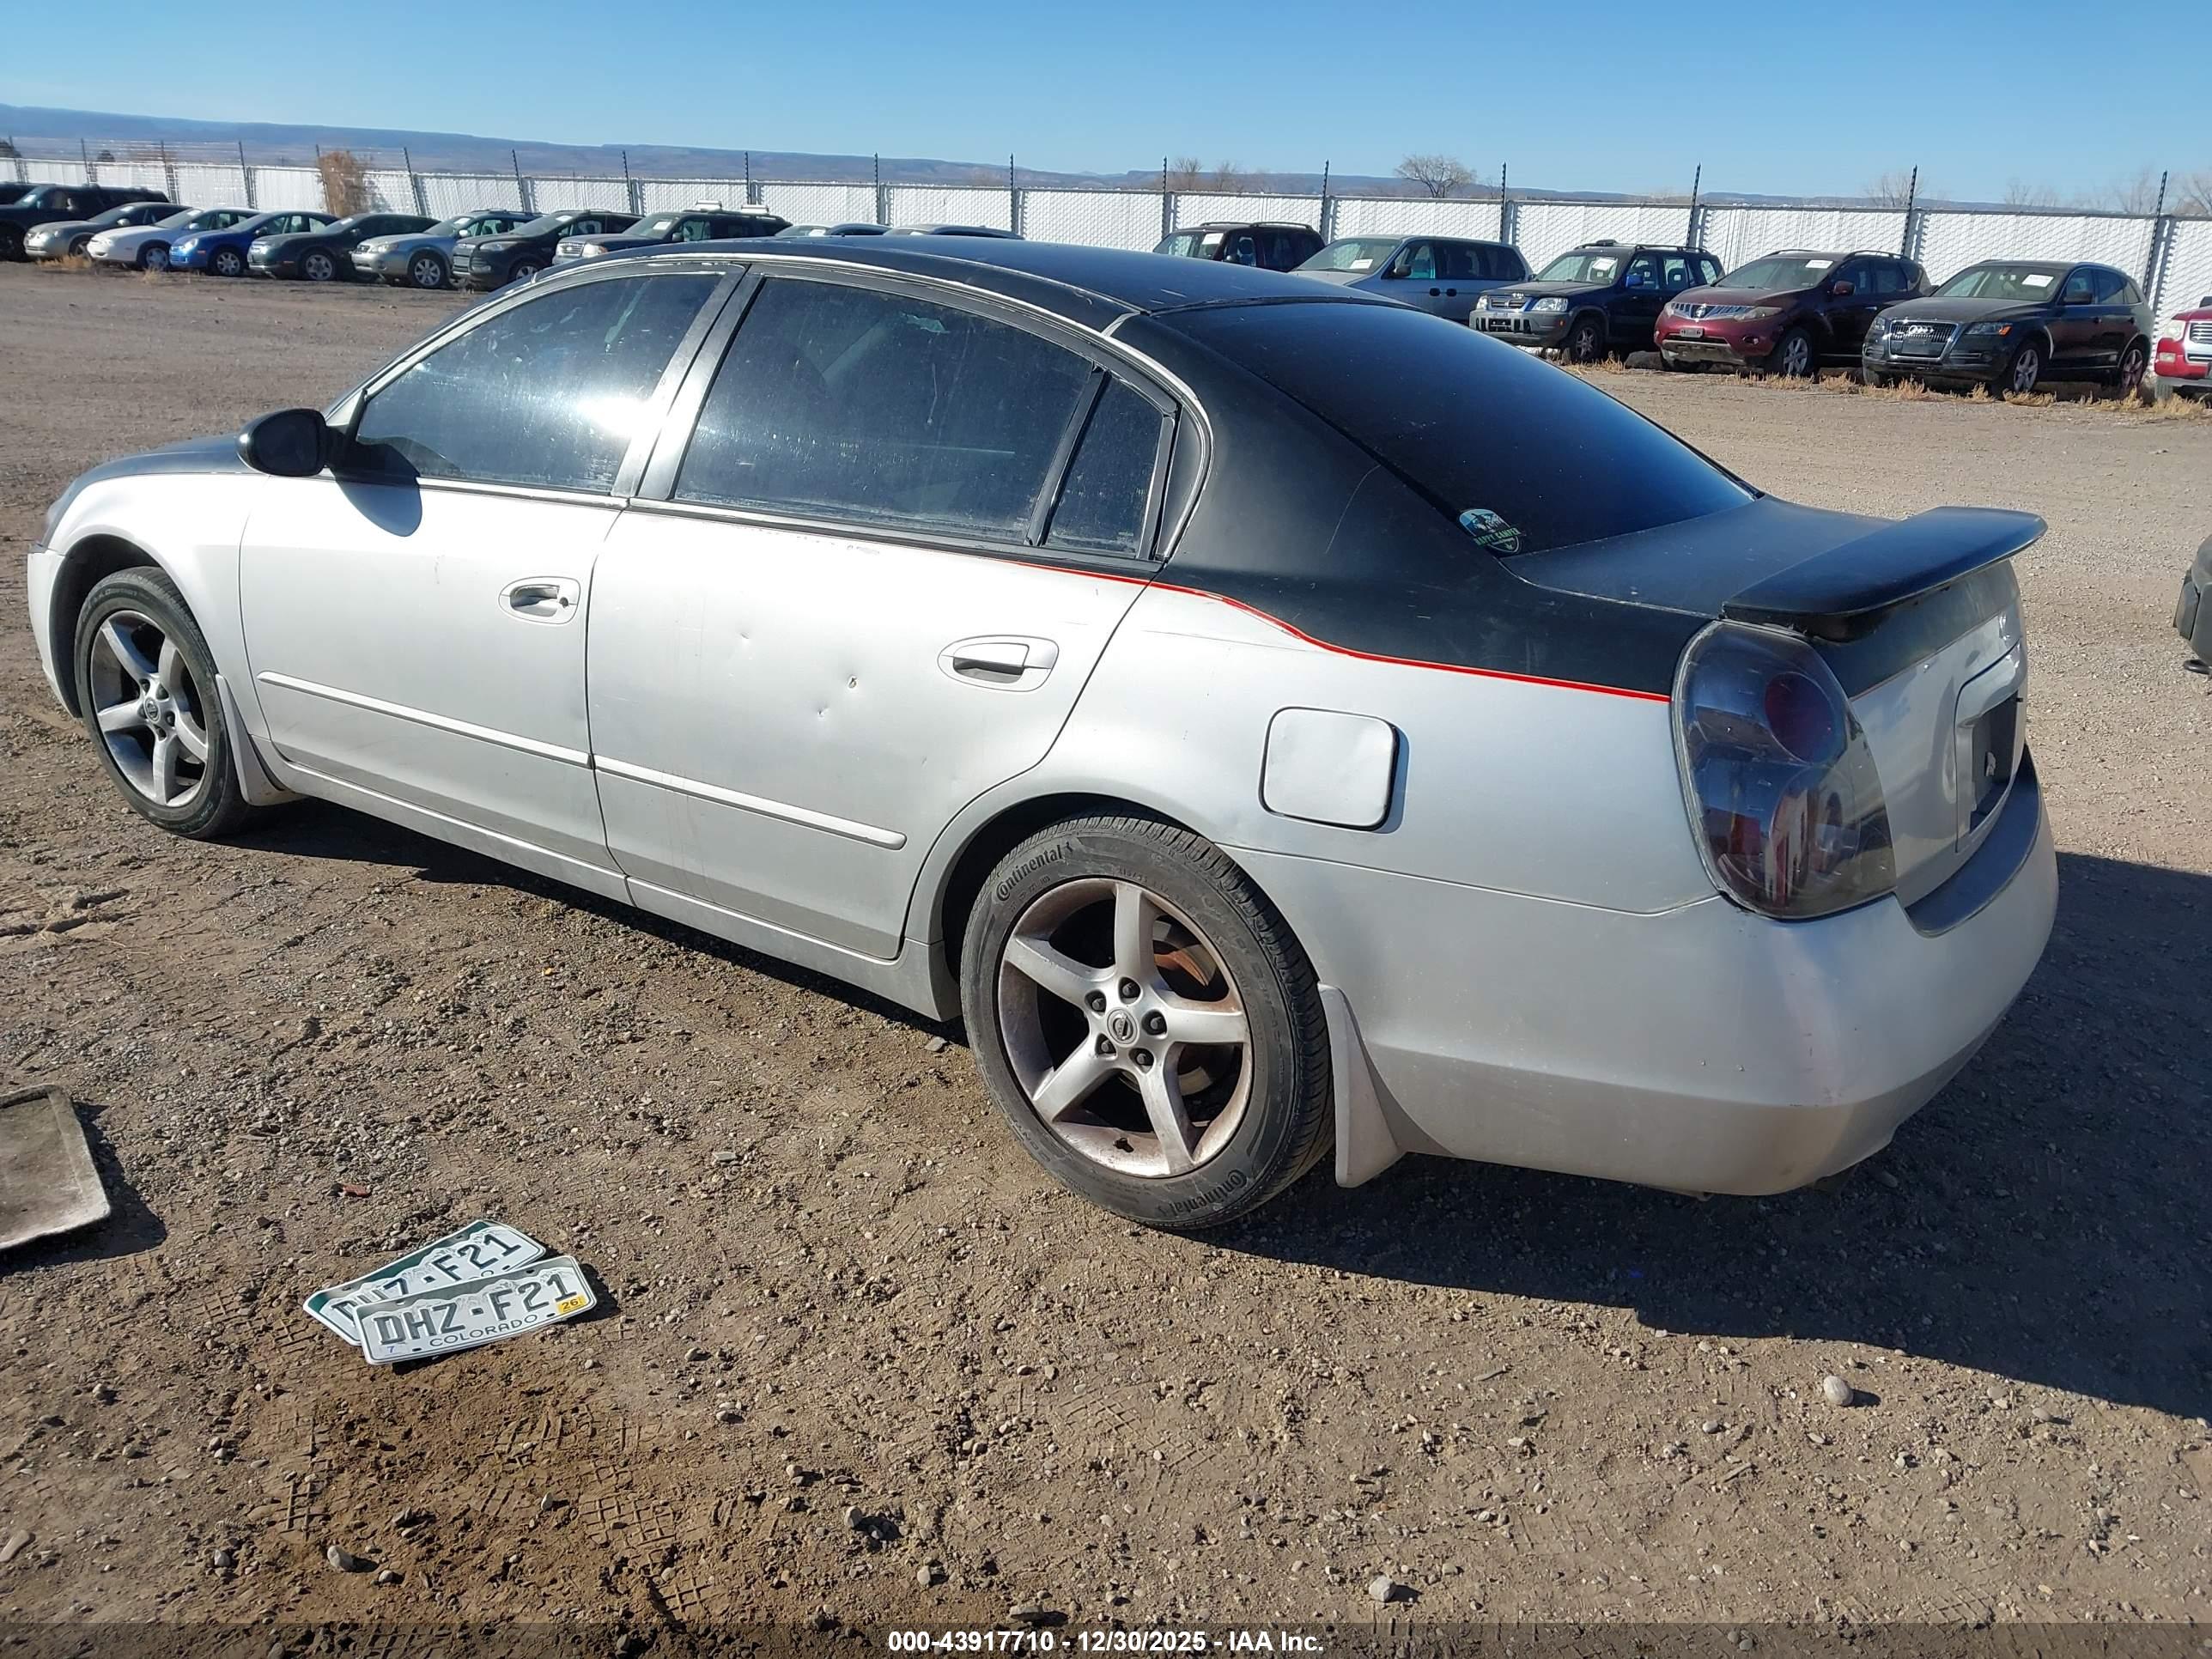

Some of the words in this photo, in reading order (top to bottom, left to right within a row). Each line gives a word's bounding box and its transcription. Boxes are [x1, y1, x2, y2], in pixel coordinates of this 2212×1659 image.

[996, 844, 1063, 902] Continental
[1168, 1169, 1248, 1217] Continental
[561, 1297, 580, 1311] 26
[428, 1314, 538, 1347] COLORADO
